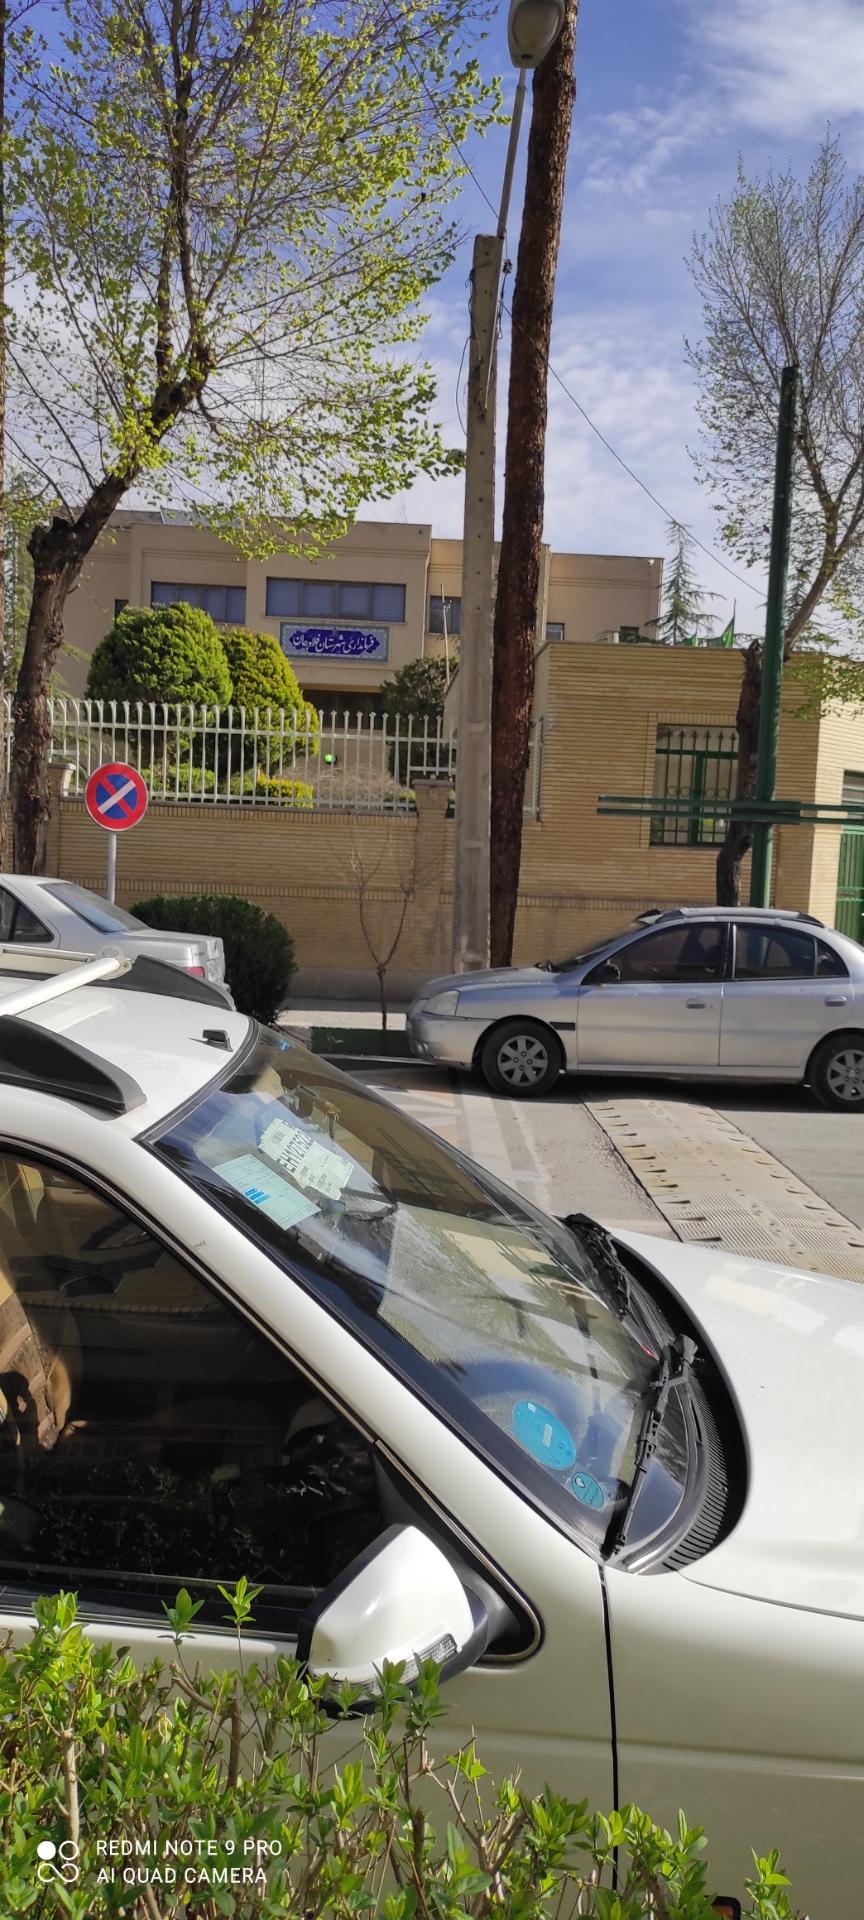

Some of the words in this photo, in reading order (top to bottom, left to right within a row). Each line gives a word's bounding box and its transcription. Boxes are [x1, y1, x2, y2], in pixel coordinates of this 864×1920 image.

[292, 633, 321, 651] فلاورجان
[315, 634, 346, 653] شهرستان
[343, 636, 375, 653] فرمانداری
